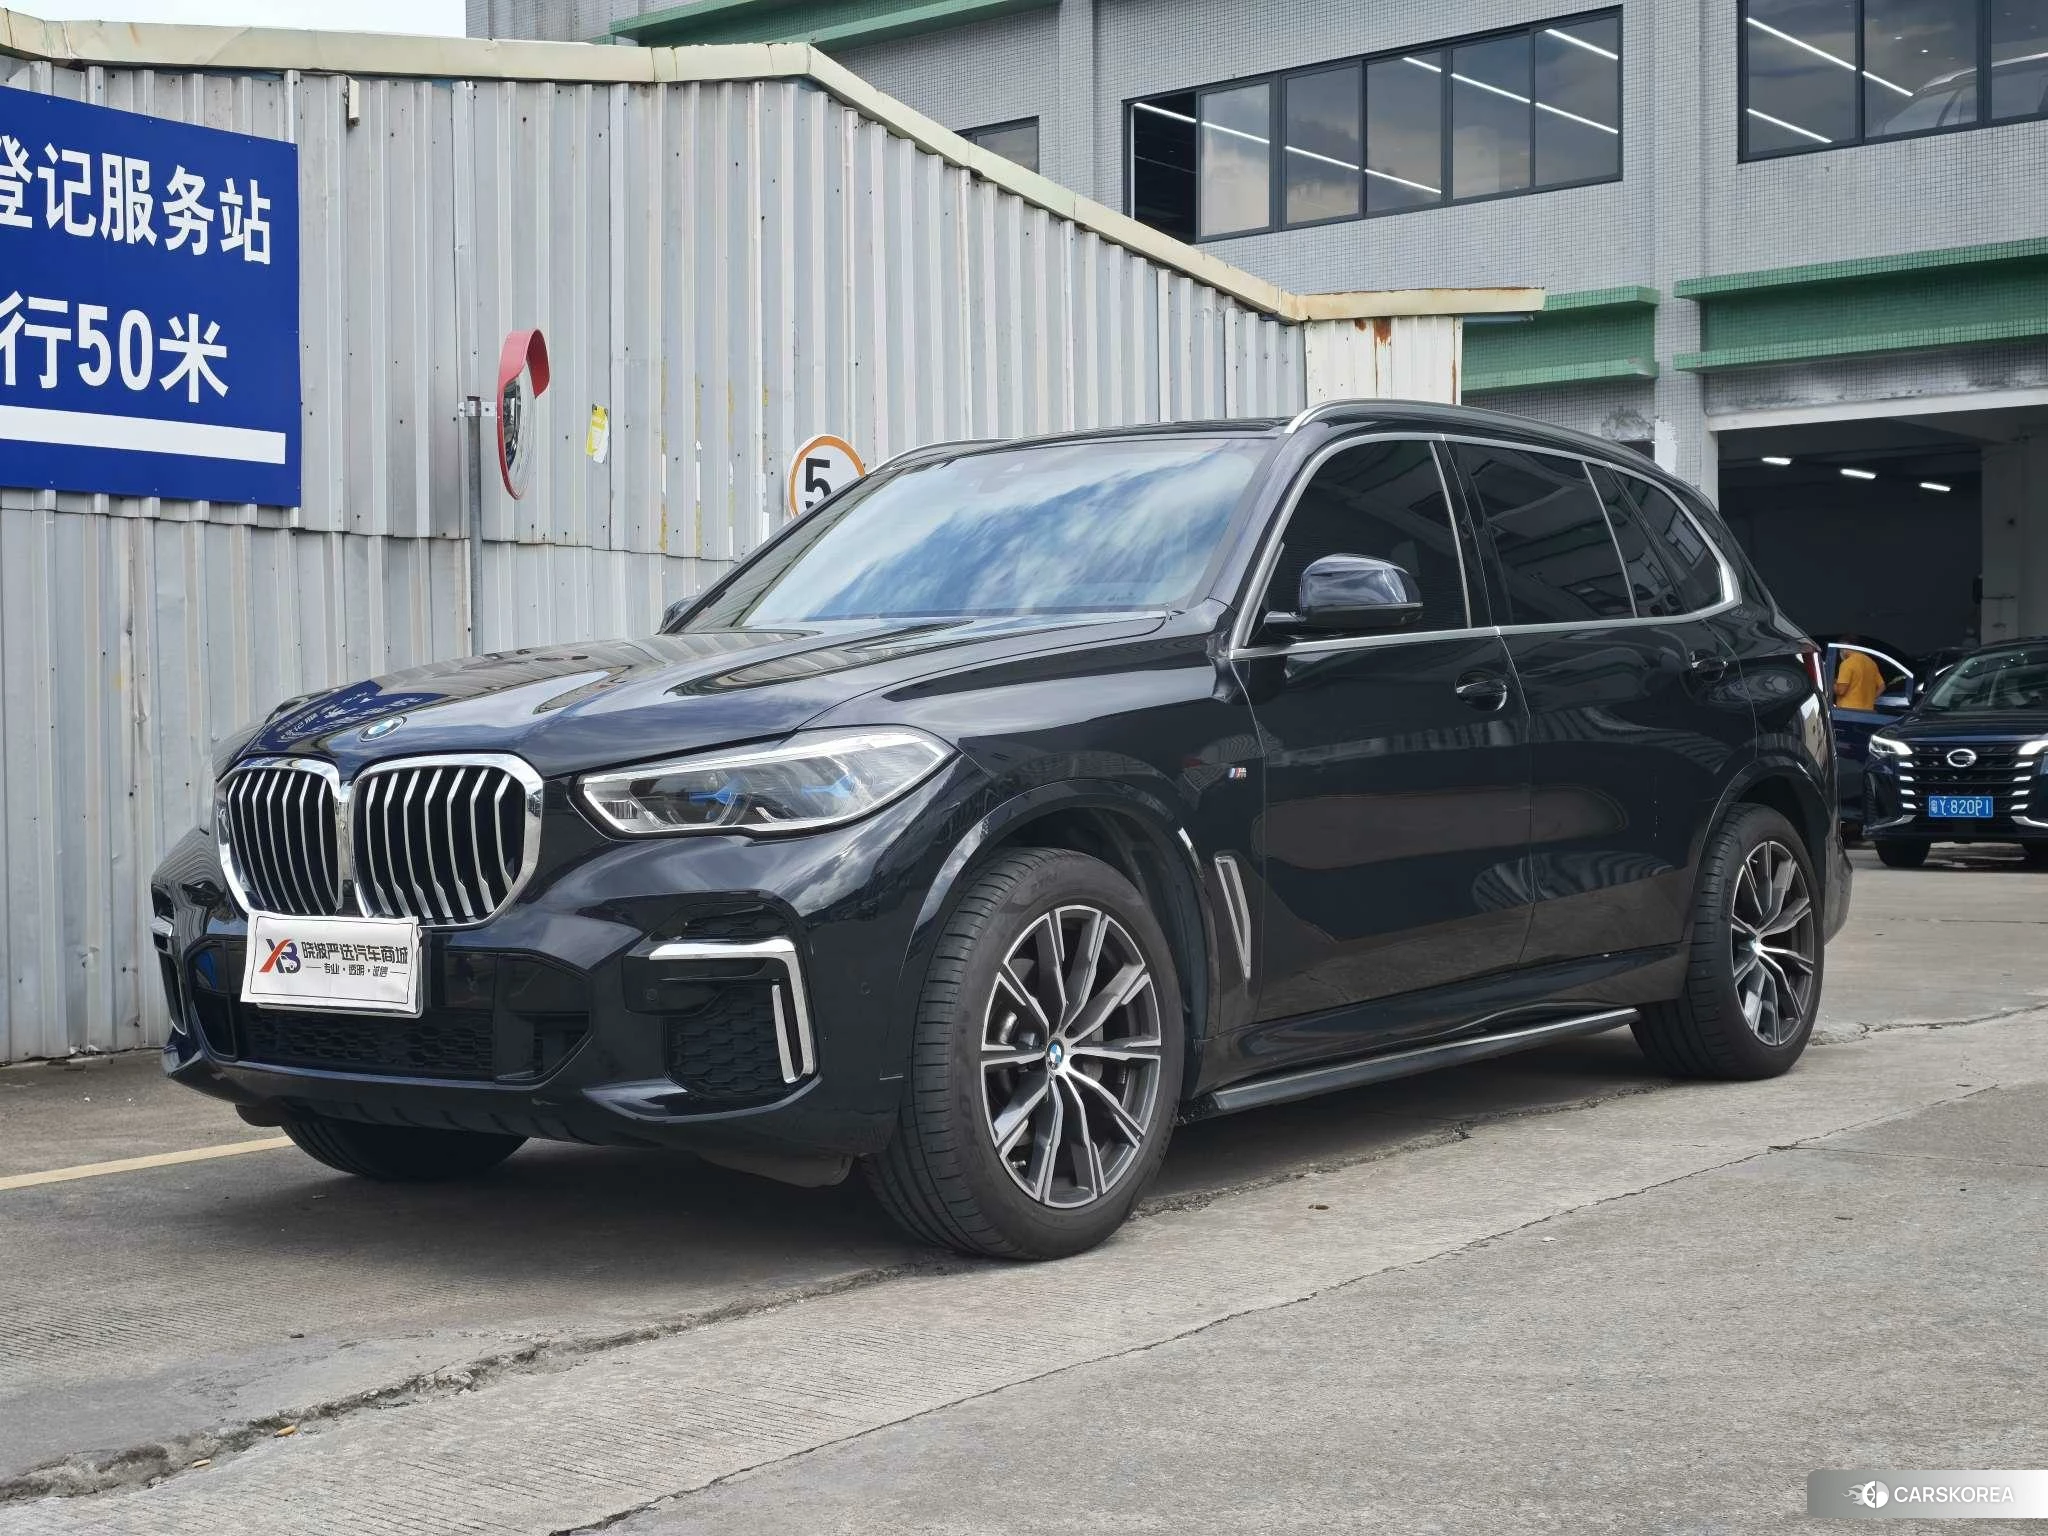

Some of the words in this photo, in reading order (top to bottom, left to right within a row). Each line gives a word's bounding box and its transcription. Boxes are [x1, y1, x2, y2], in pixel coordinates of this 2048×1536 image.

[0, 290, 229, 403] 行50米
[805, 458, 831, 510] 5
[301, 941, 408, 964] 晓波严选汽车商城
